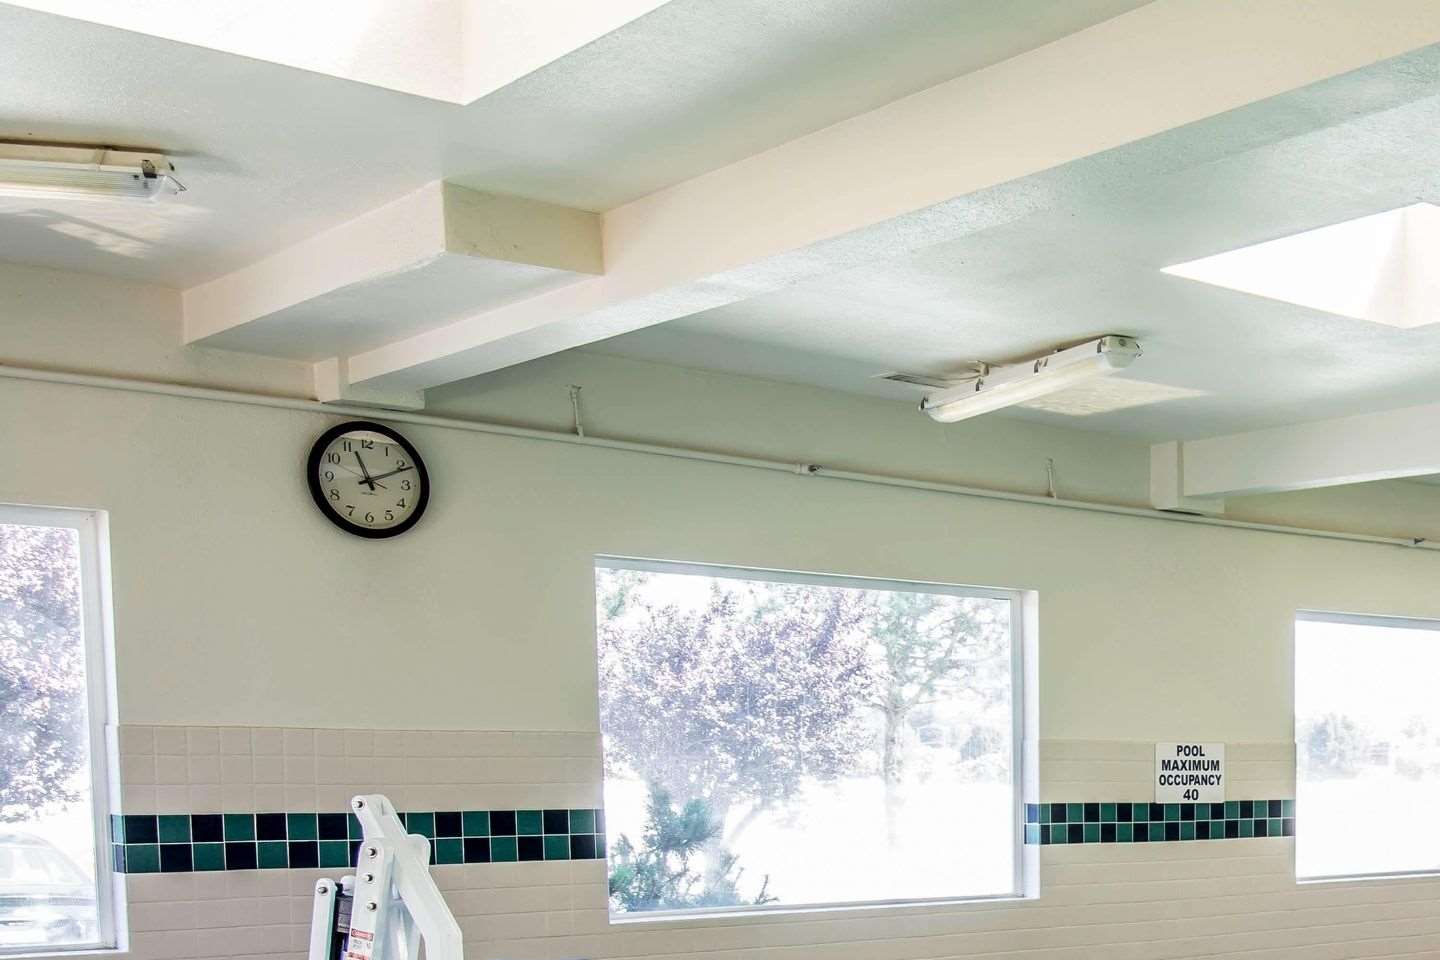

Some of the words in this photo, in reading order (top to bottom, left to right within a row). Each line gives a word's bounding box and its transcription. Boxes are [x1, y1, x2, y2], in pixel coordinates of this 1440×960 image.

[343, 441, 352, 452] 11
[361, 440, 374, 449] 12
[327, 453, 340, 464] 10
[325, 471, 334, 482] 9
[400, 480, 411, 491] 3
[330, 489, 340, 501] 8
[396, 498, 406, 509] 4
[345, 505, 355, 516] 7
[384, 510, 394, 521] 5
[365, 512, 374, 523] 6
[1176, 745, 1205, 757] POOL
[1161, 759, 1220, 771] MAXIMUM
[1159, 774, 1222, 786] OCCUPANCY
[1182, 789, 1199, 801] 40
